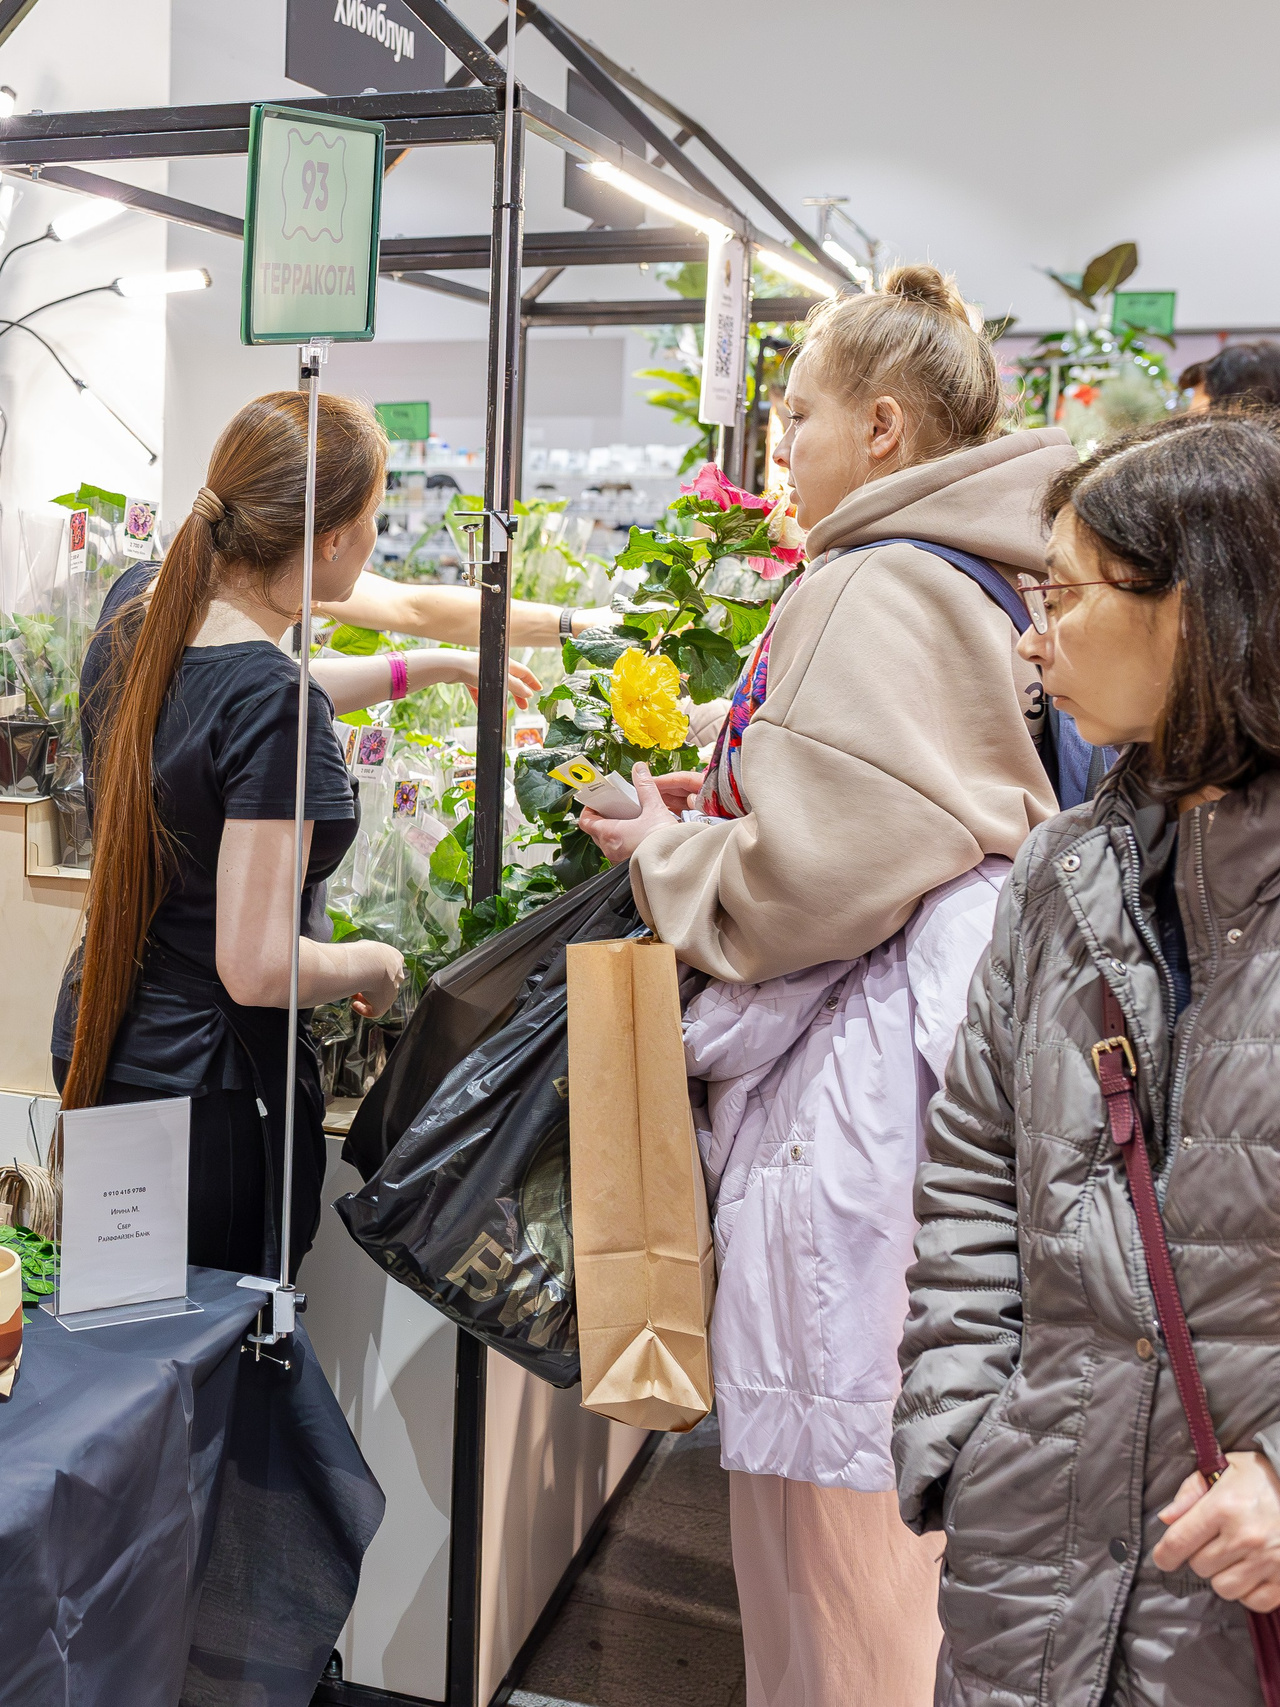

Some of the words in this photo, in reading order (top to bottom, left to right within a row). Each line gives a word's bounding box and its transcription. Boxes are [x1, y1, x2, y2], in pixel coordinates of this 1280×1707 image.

[302, 159, 330, 211] 93
[260, 262, 356, 296] ТЕРРАКОТА
[131, 1205, 140, 1213] М.
